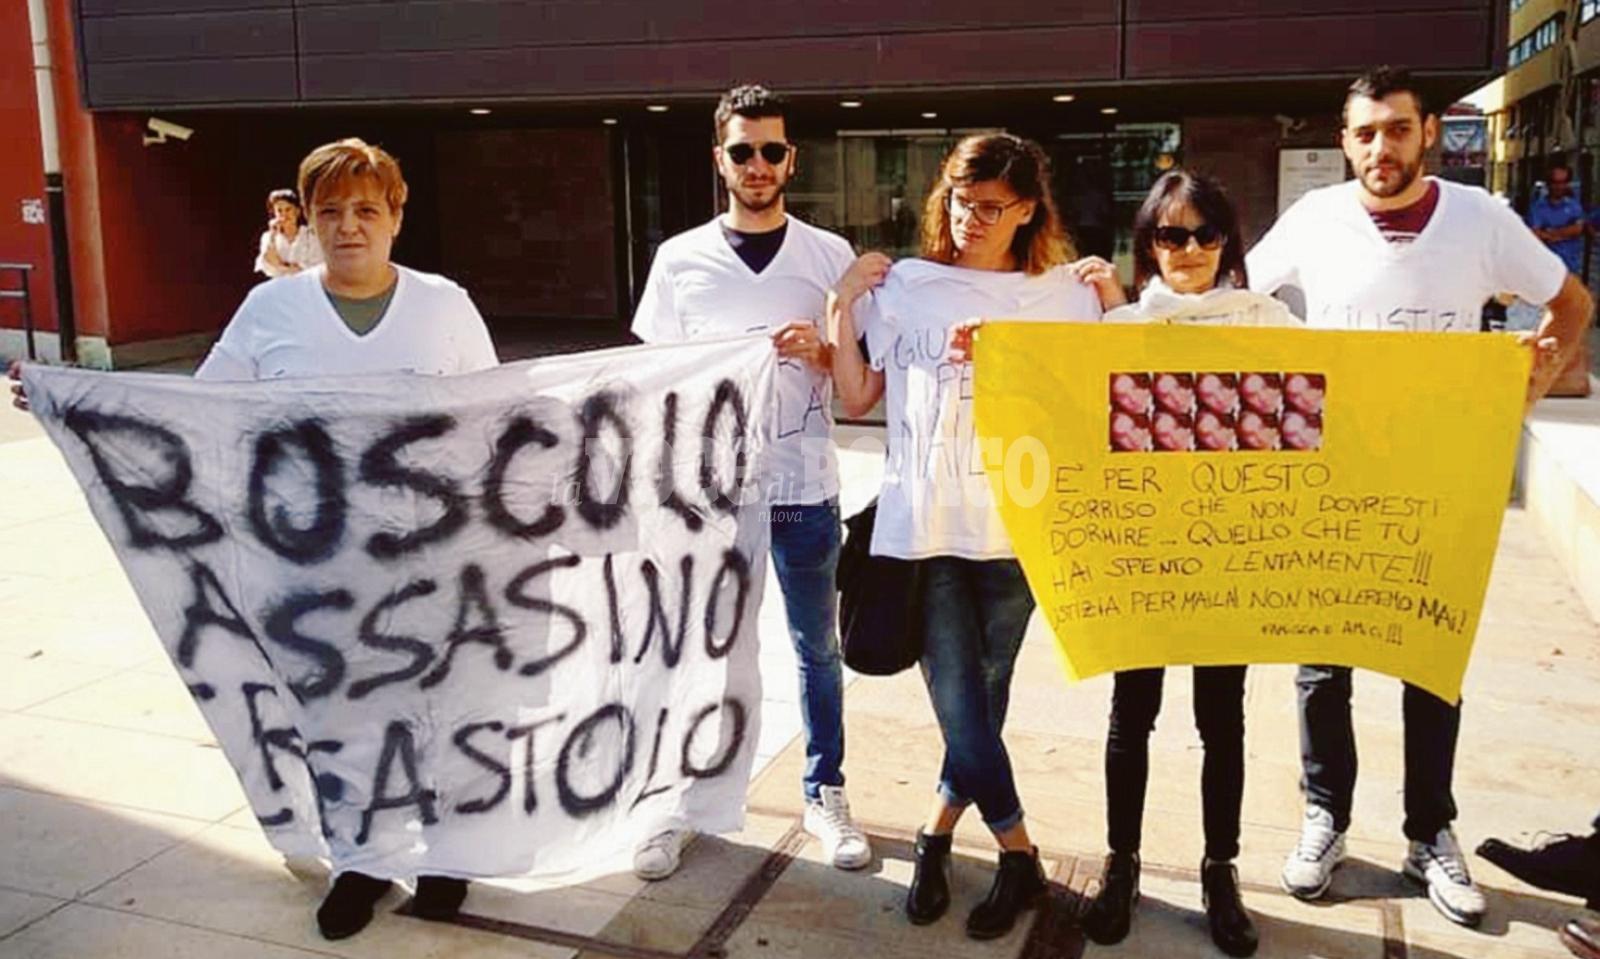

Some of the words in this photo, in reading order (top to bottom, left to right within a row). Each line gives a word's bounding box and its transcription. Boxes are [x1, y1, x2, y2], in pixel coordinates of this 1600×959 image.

[936, 362, 976, 402] PE
[62, 378, 753, 566] BOSCOLO
[1102, 465, 1164, 494] PER
[1190, 461, 1332, 494] QUESTO
[1052, 498, 1157, 525] SORRISO
[1180, 497, 1229, 518] CHE
[1248, 500, 1298, 520] NON
[1318, 494, 1440, 519] DOVRESTI
[1050, 523, 1152, 556] DORMIRE
[1186, 519, 1292, 548] QUELLO
[1300, 517, 1362, 543] CHE
[1377, 521, 1421, 546] TU
[1052, 559, 1093, 594] HAI
[1103, 556, 1204, 578] SPENTO
[1130, 590, 1177, 614] PER
[1249, 588, 1303, 609] NON
[1308, 587, 1415, 612] MOLLEREMO
[176, 547, 752, 703] ASSASINO
